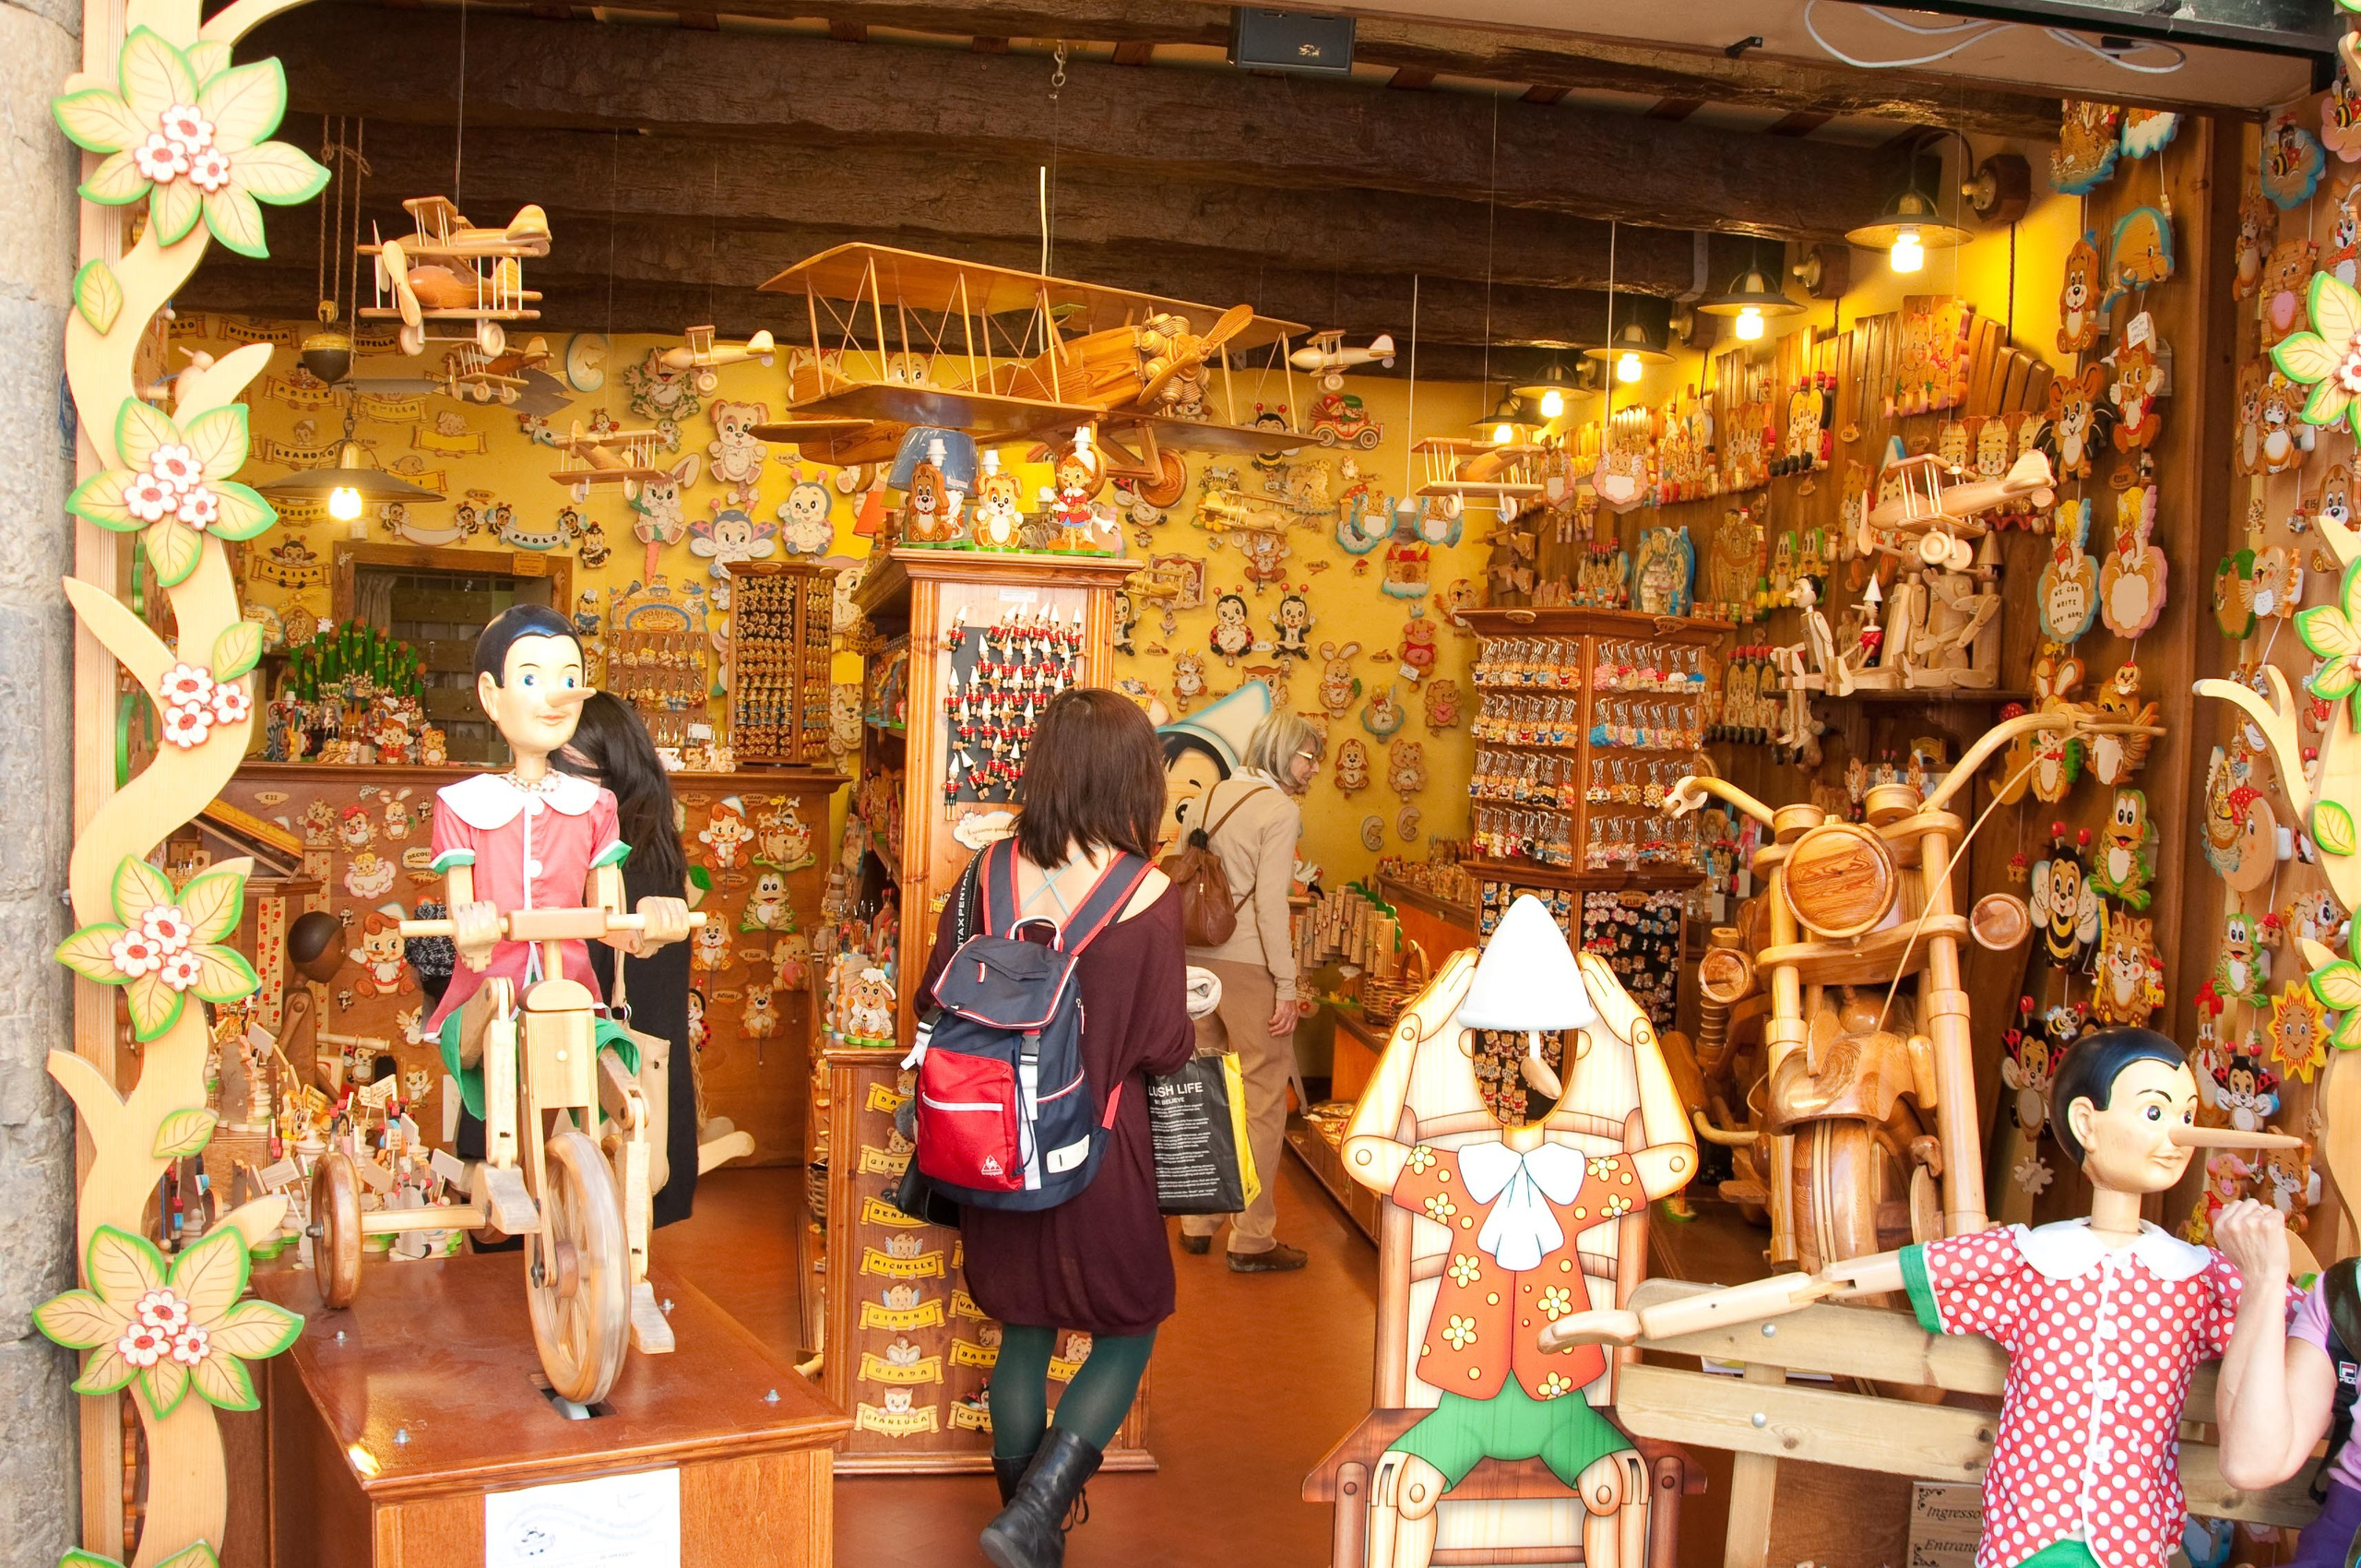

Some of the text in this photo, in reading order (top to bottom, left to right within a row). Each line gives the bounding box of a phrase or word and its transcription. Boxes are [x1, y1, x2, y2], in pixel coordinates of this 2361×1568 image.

[230, 327, 289, 340] VITTORIA
[365, 404, 417, 413] AMILLA
[271, 505, 326, 516] IUSEPPE
[514, 534, 558, 544] PAOLO
[267, 566, 318, 577] LAILA
[407, 851, 432, 860] DECOU
[1148, 1081, 1204, 1098] LUSH LIFE
[1161, 1097, 1185, 1105] BELIEVE
[873, 1259, 934, 1270] MICHELLE
[872, 1311, 930, 1322] GIANNI
[875, 1368, 927, 1377] GIADA
[865, 1414, 928, 1426] GIANLUCA
[958, 1412, 992, 1422] COST
[1927, 1506, 1981, 1521] Ingresso
